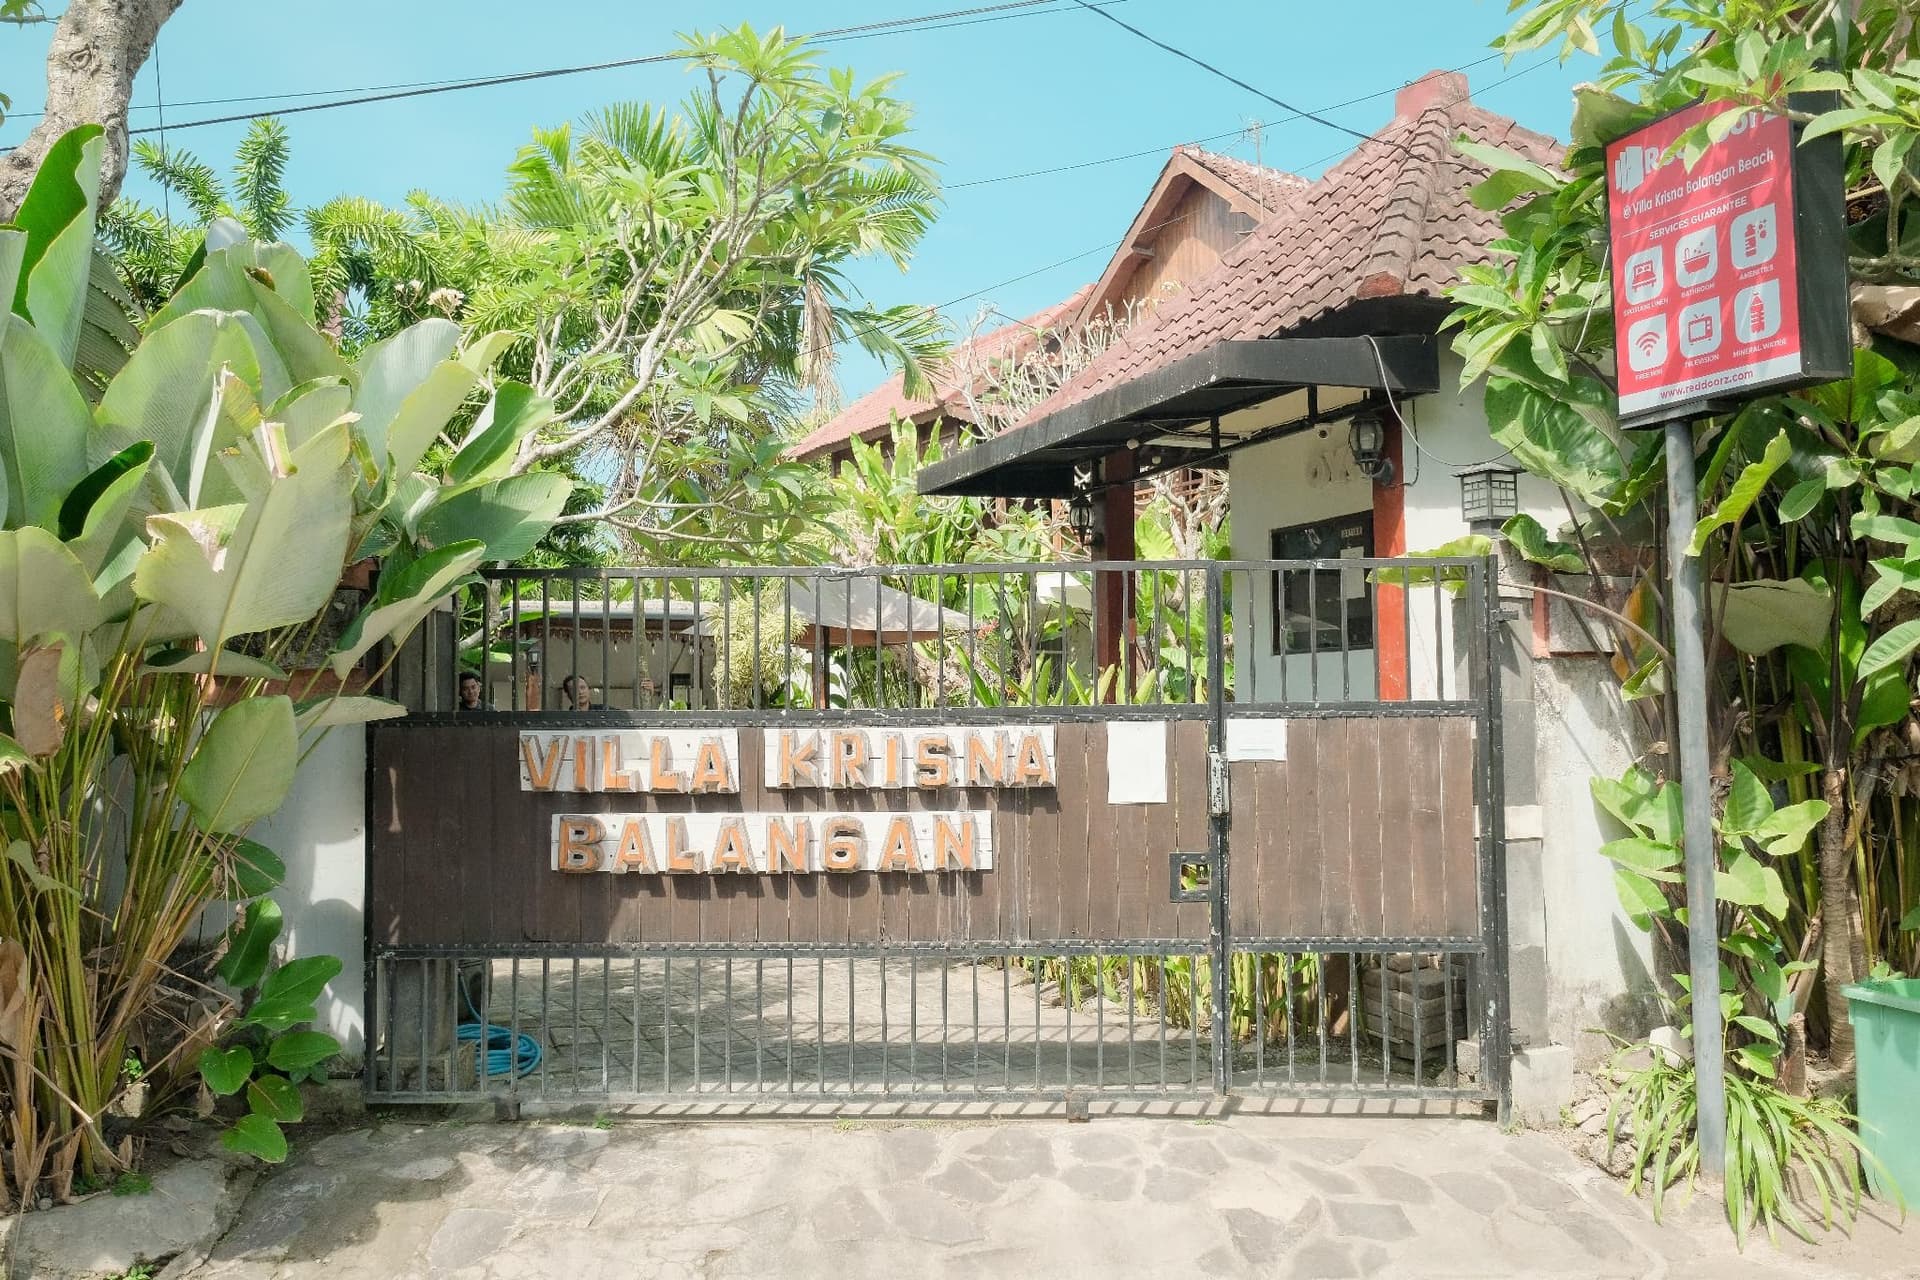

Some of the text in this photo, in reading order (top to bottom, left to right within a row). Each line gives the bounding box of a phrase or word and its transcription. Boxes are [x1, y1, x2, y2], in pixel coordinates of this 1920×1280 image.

[1632, 199, 1653, 215] Villa
[1655, 187, 1684, 207] Krisna
[1686, 166, 1736, 193] Balangan
[1738, 148, 1774, 173] Beach
[1649, 196, 1747, 240] SERVICES GUARANTEE
[1660, 370, 1754, 400] www.reddoorz.com
[521, 729, 1056, 793] VILLA KRISNA
